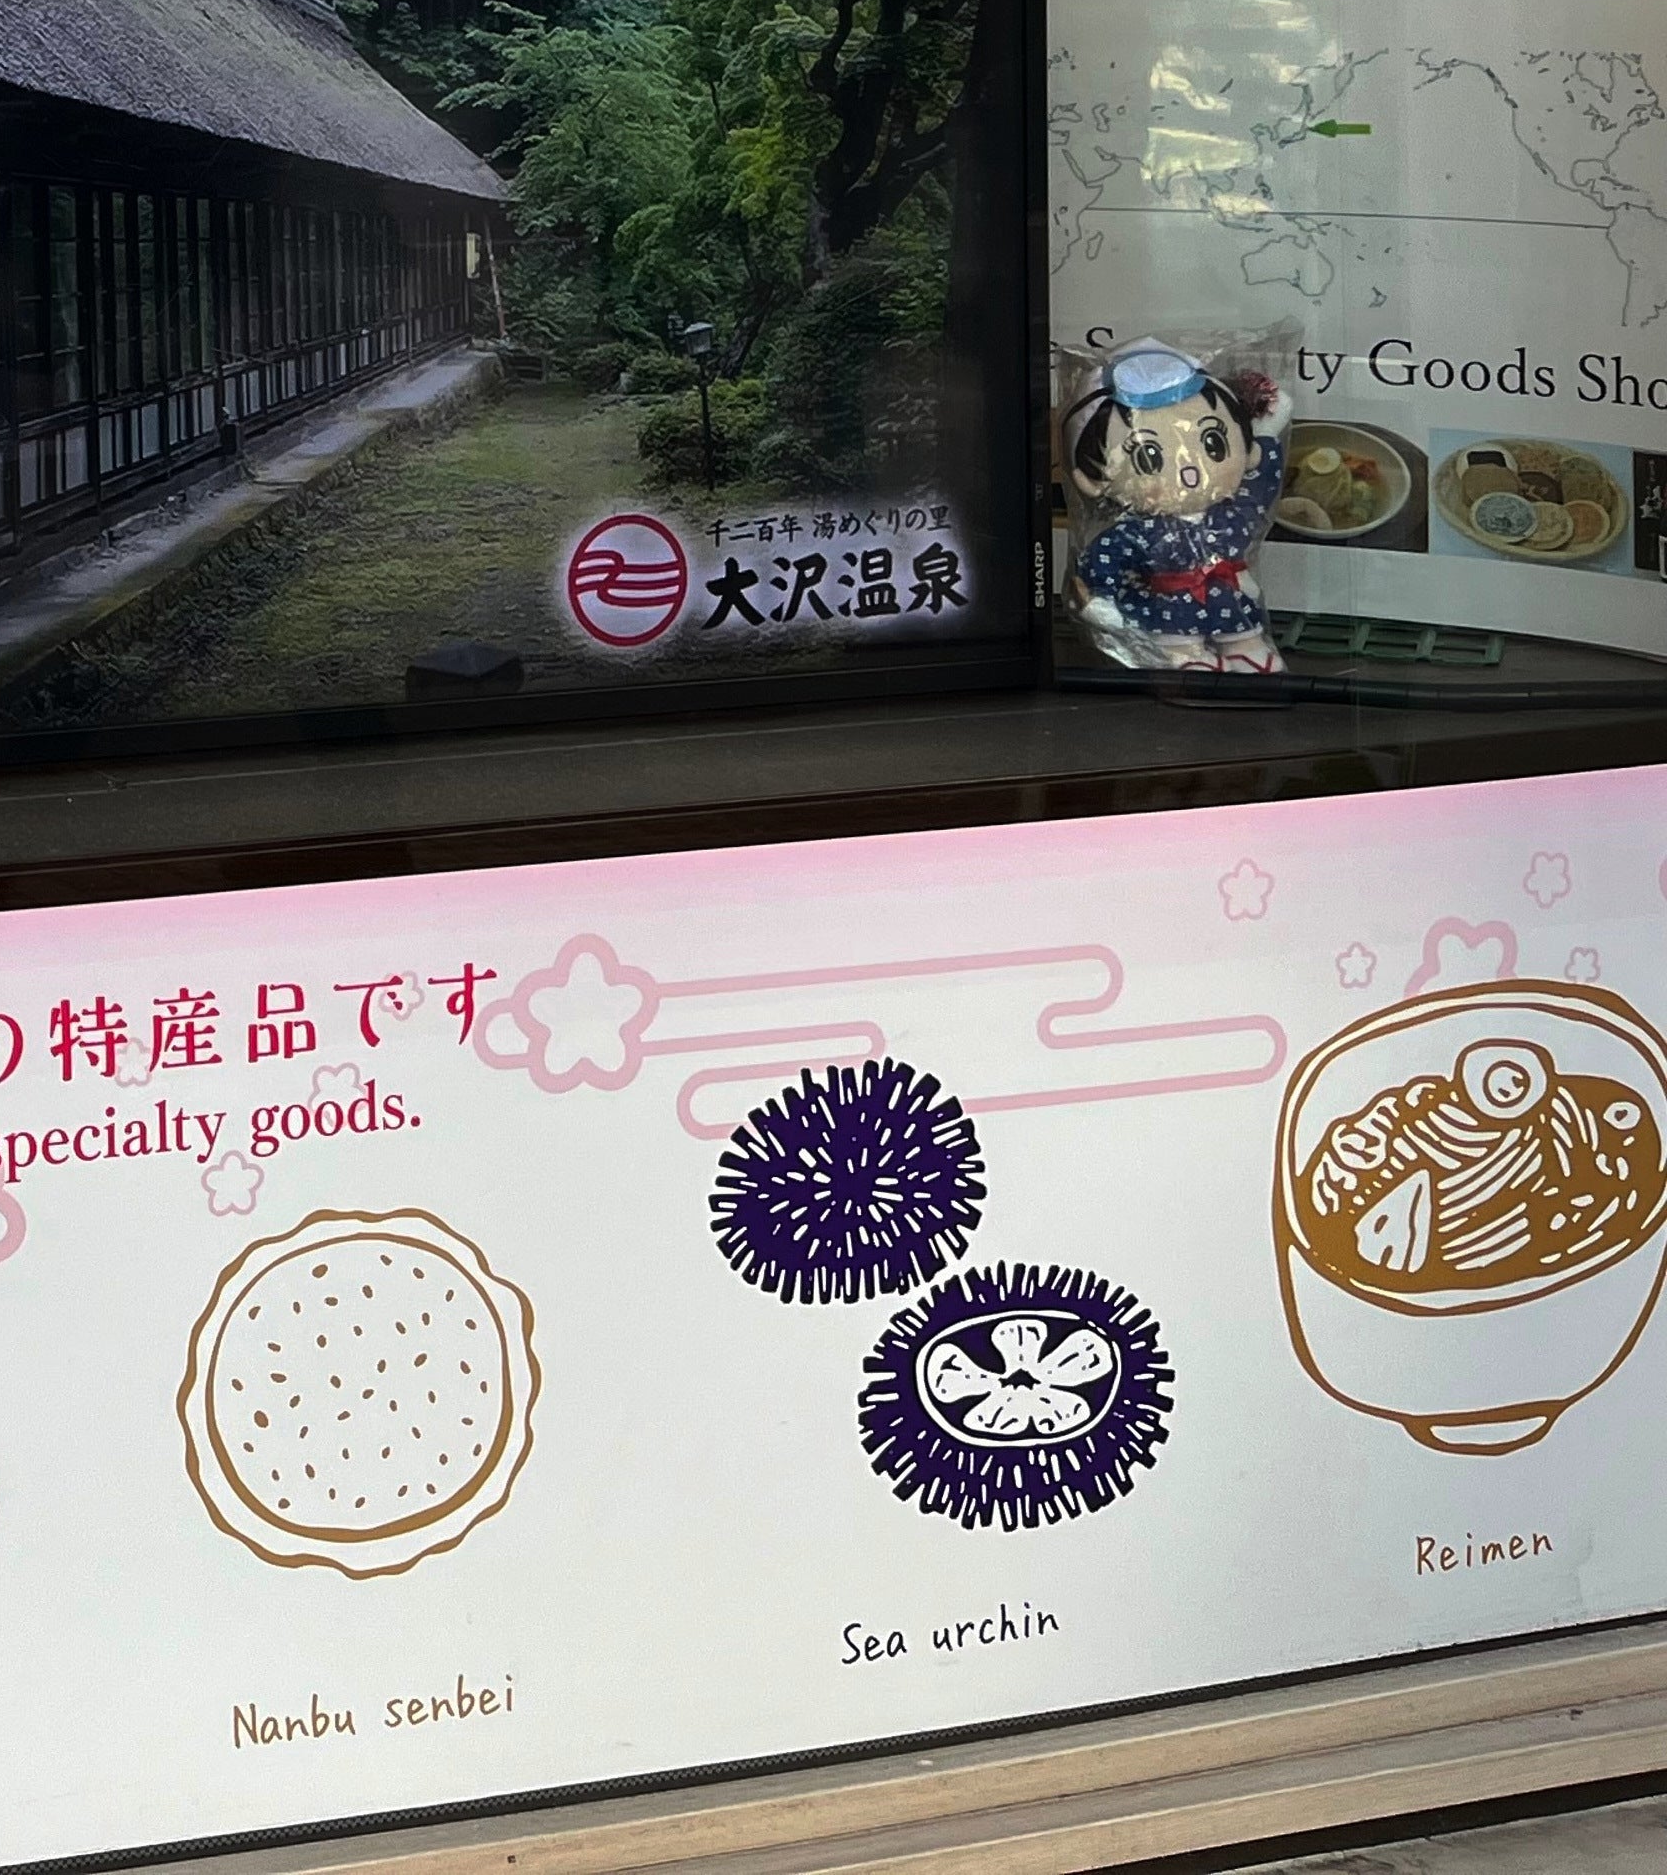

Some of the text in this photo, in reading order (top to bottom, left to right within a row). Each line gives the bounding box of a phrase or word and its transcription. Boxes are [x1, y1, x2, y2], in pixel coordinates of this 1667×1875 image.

[1367, 338, 1556, 398] Goods
[705, 506, 952, 548] 千二百年 湯めぐりの里
[701, 541, 968, 630] 大沢温泉
[1034, 541, 1045, 608] SHARP
[249, 1079, 423, 1162] goods.
[1415, 1531, 1554, 1577] Reimen
[841, 1602, 1060, 1665] Sea urchin
[233, 1673, 513, 1749] Nanbu senbei
